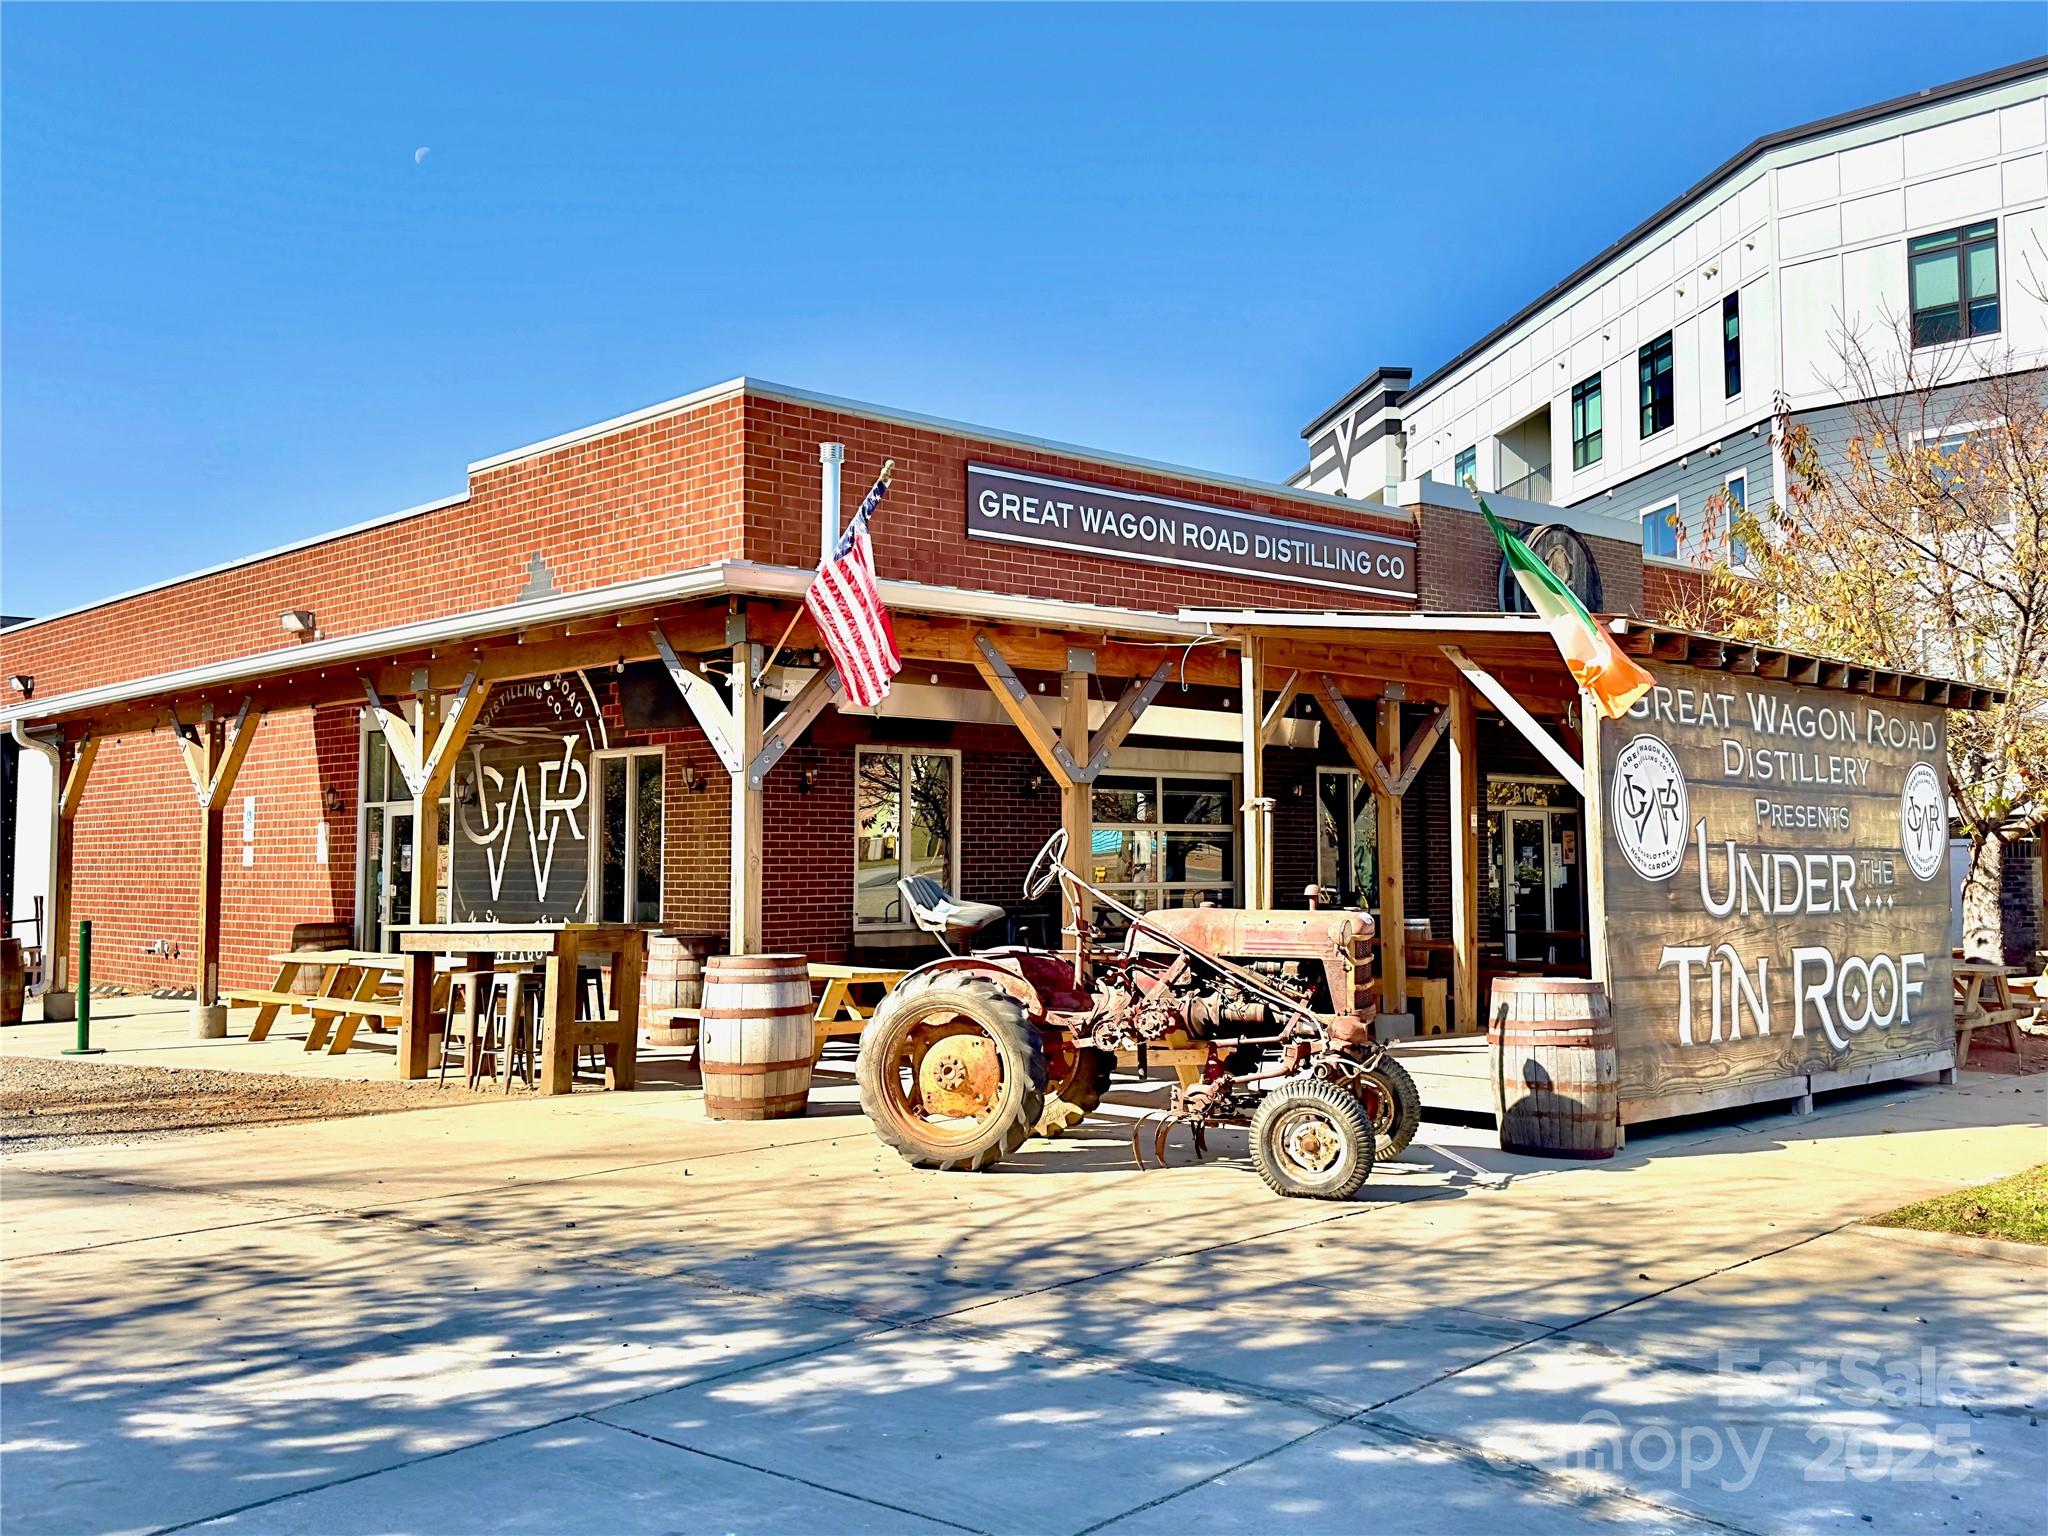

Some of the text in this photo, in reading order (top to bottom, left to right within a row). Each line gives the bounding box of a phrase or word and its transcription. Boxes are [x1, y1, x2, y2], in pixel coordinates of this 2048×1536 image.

[979, 489, 1405, 580] GREAT WAGON ROAD DISTILLING CO
[483, 683, 543, 726] DISTILLING
[1746, 691, 1857, 743] WAGON
[1867, 708, 1937, 751] ROAD
[1722, 738, 1871, 787] DISTILLERY
[1755, 798, 1850, 830] PRESENTS
[1695, 816, 1894, 919] UNDER THE
[1658, 942, 1928, 1051] TIN ROOF
